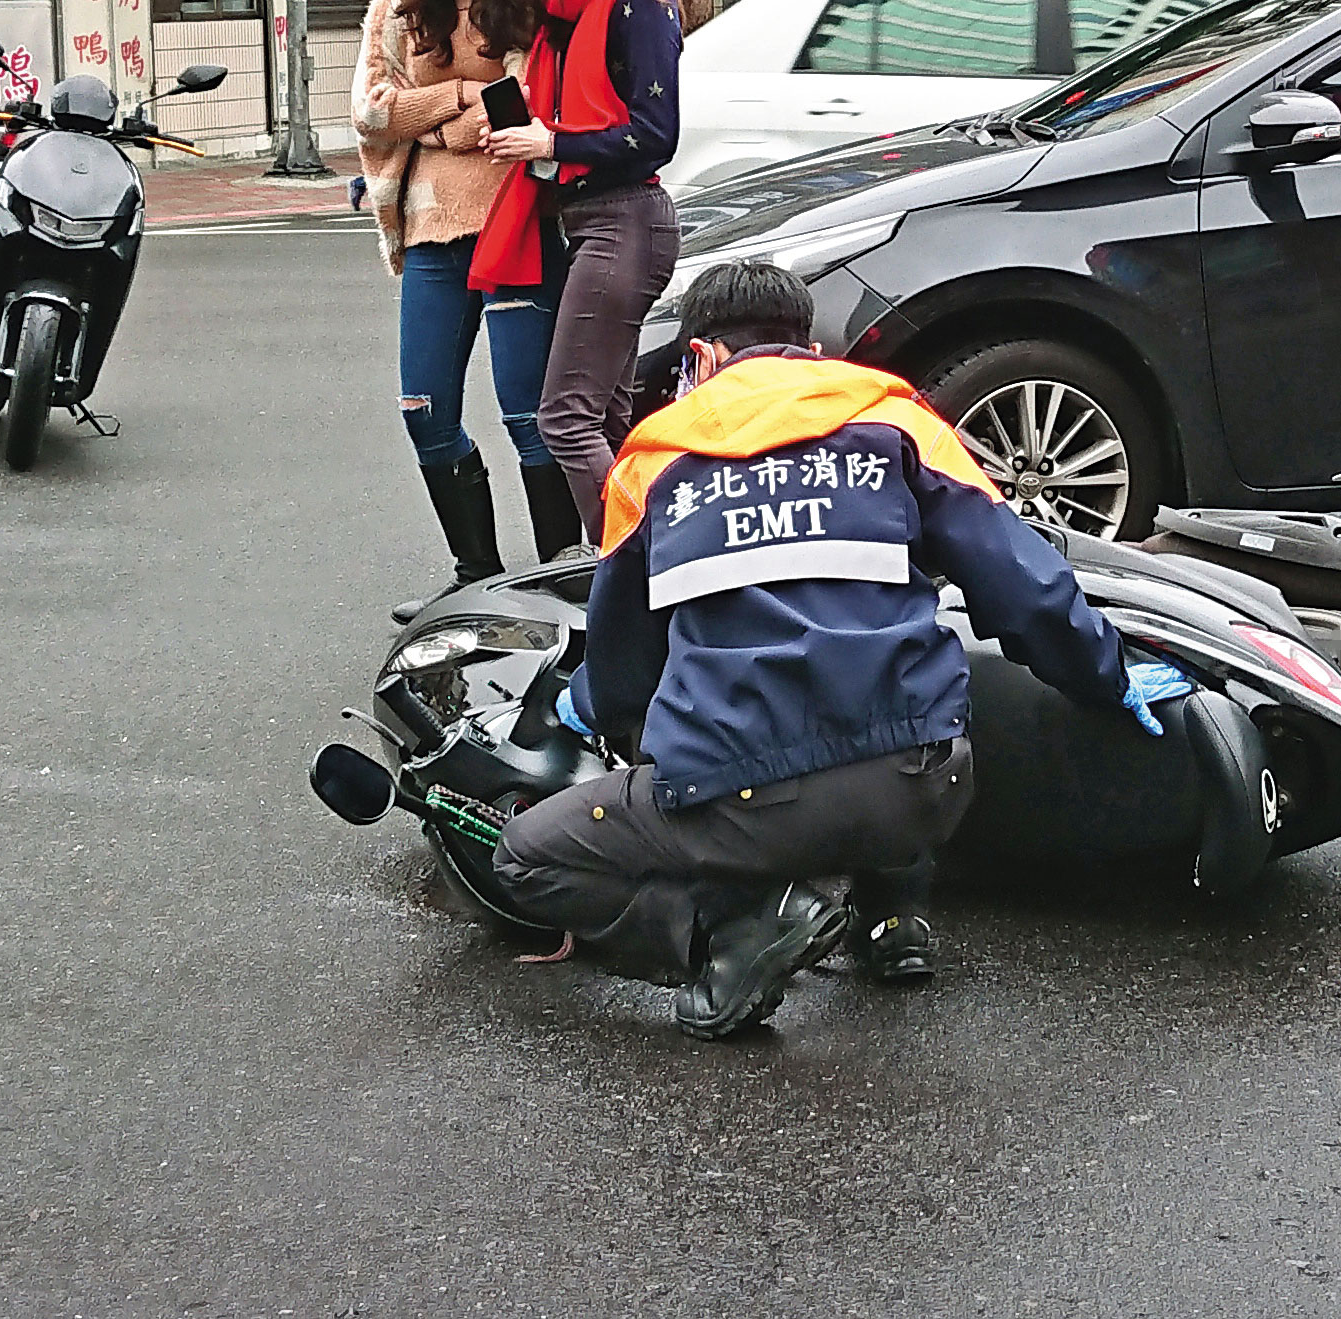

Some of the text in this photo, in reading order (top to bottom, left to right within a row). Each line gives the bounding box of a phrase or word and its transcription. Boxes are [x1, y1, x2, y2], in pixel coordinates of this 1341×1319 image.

[665, 447, 890, 527] 臺北市消防
[721, 497, 833, 548] EMT
